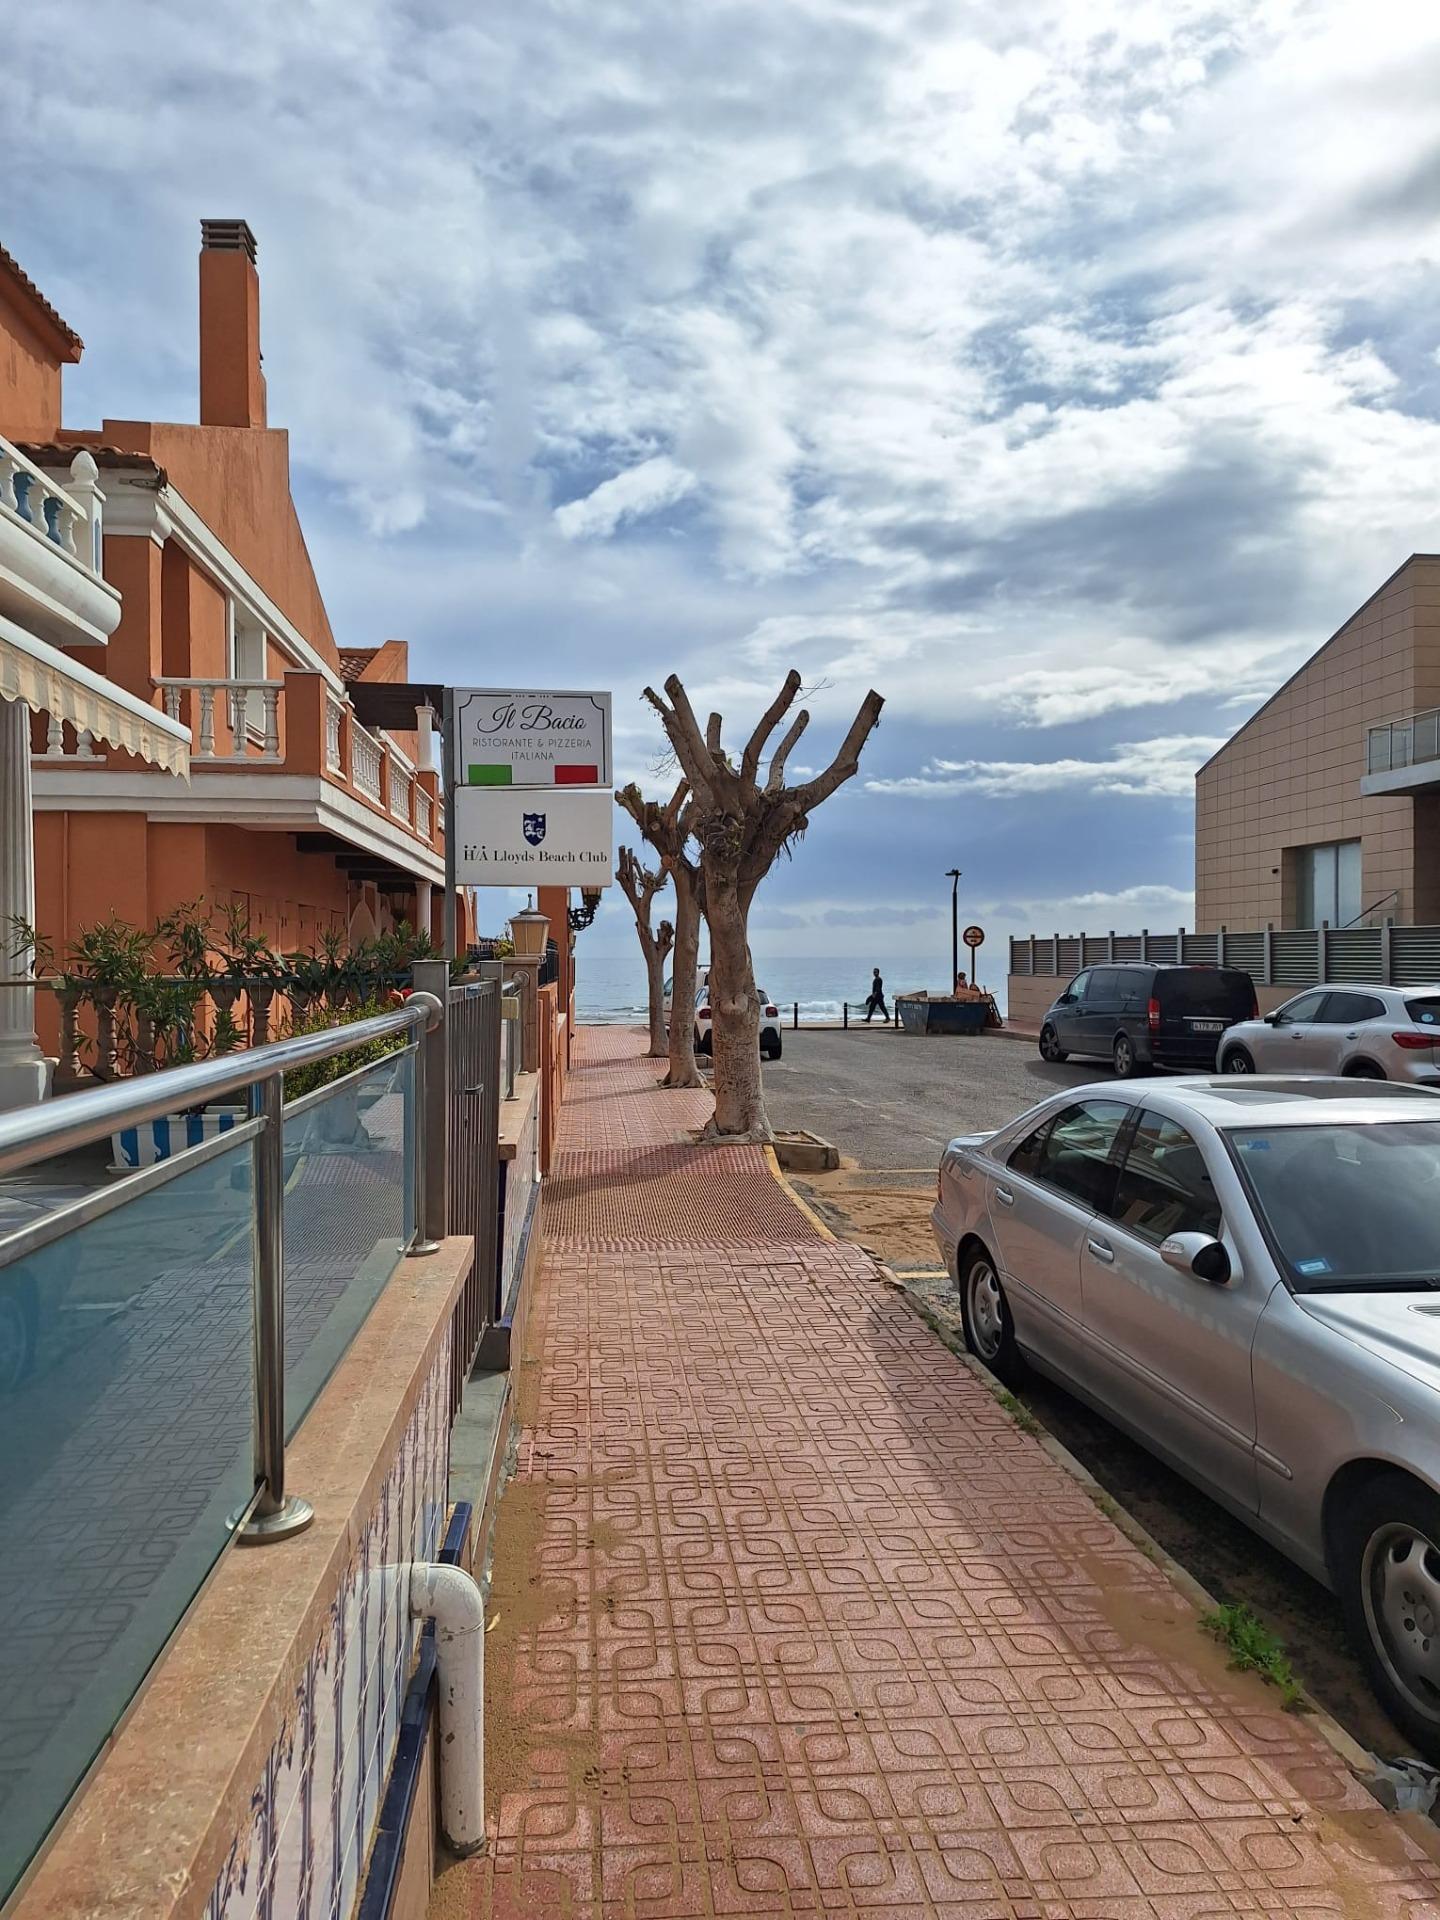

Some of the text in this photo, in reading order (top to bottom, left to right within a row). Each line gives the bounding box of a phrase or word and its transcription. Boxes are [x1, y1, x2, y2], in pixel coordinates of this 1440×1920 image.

[477, 703, 586, 731] Il Bacio
[473, 738, 591, 748] RISTORANTE & PIZZERIA
[511, 752, 554, 760] ITALIANA
[494, 850, 535, 864] Lloyds
[539, 851, 575, 862] Beach
[579, 851, 608, 863] Club
